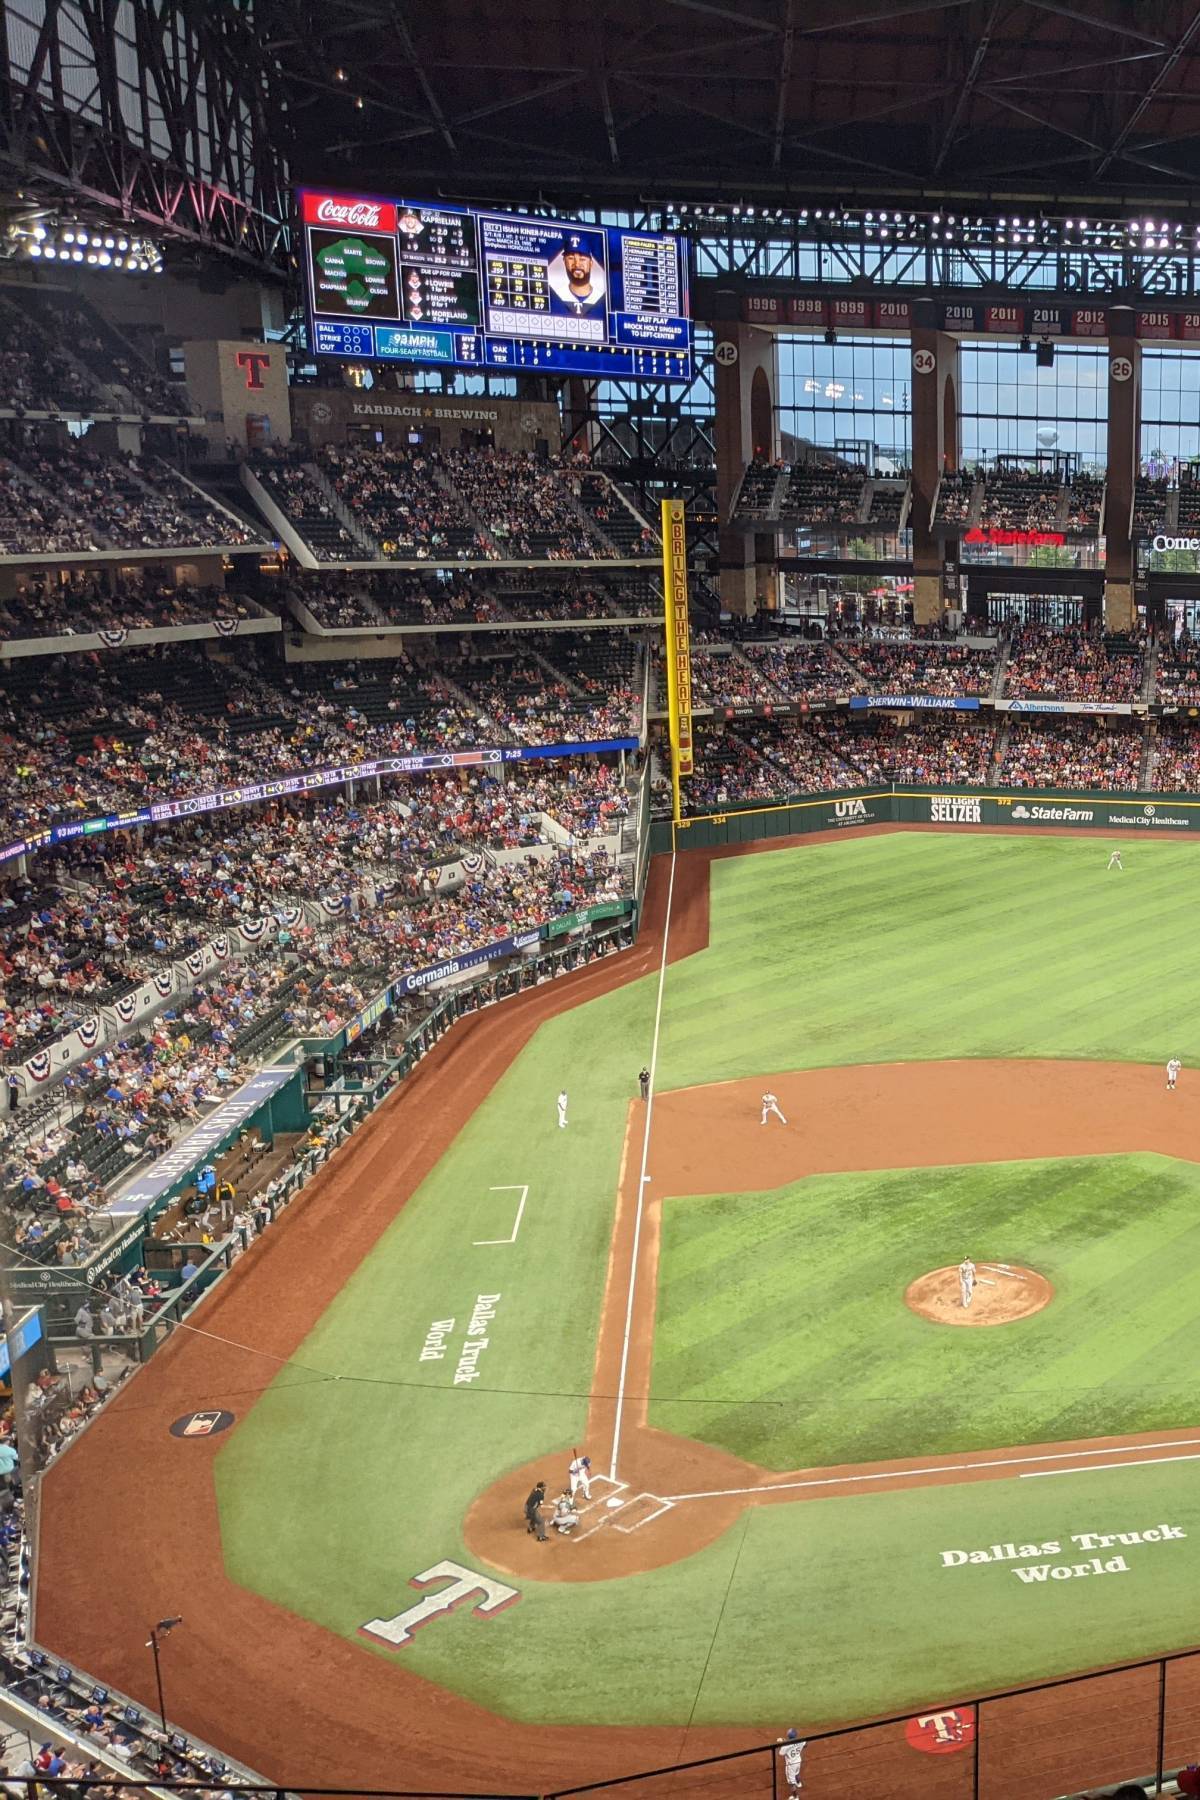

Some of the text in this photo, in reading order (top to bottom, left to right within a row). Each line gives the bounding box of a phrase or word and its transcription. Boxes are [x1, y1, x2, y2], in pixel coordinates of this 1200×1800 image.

[748, 298, 777, 311] 1996
[793, 300, 822, 312] 1998
[835, 302, 865, 314] 1999
[880, 304, 908, 316] 2010
[946, 307, 973, 319] 2010
[991, 308, 1017, 320] 2011
[1033, 310, 1059, 322] 2011
[1077, 311, 1105, 324] 2012
[1141, 313, 1169, 326] 2015
[319, 325, 335, 333] BALL
[717, 346, 735, 361] 42
[915, 355, 932, 368] 34
[236, 352, 271, 389] T
[1112, 363, 1130, 376] 26
[353, 404, 497, 420] KARBACH BREWING
[1024, 703, 1065, 712] Albertsons
[931, 796, 981, 805] BUD LIGHT
[835, 800, 866, 816] UTA
[931, 805, 981, 823] SELTZER
[712, 817, 727, 825] 334
[1109, 815, 1189, 826] Medical City Healthcare
[406, 949, 502, 989] Germania INSURANCE
[148, 1100, 257, 1179] TEXAS RANGERS
[419, 1317, 456, 1362] World
[453, 1293, 501, 1385] Dallas Truck
[938, 1523, 1188, 1568] Dallas Truck
[1011, 1555, 1131, 1584] World
[360, 1557, 522, 1650] T
